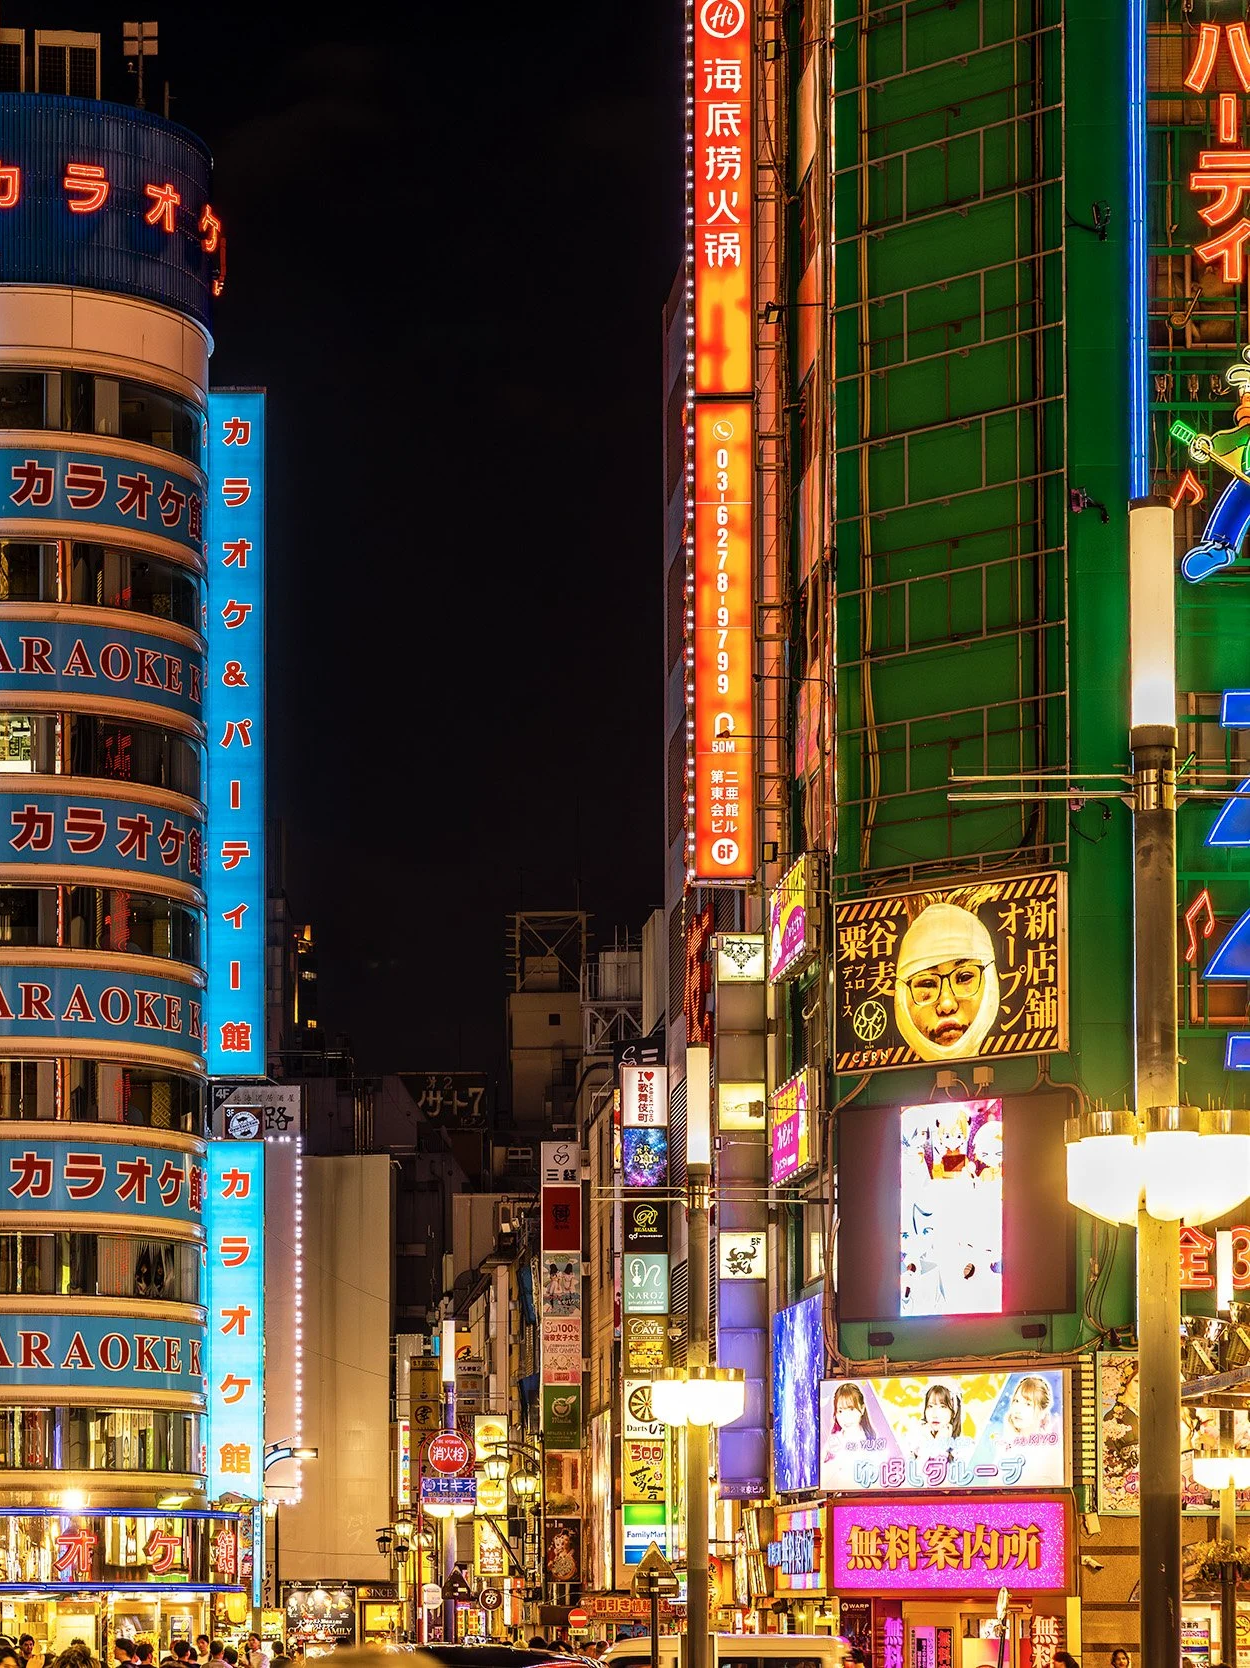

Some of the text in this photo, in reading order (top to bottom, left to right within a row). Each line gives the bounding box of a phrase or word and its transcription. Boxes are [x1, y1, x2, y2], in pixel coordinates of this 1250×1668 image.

[703, 57, 742, 268] 海底捞火锅
[716, 448, 730, 694] 03-6278-9799
[711, 740, 736, 753] 50M
[717, 844, 734, 859] 6F
[996, 901, 1027, 1033] オープン
[1023, 896, 1060, 1031] 新店舗
[852, 1050, 890, 1063] CERN
[215, 1088, 230, 1099] 4F
[638, 1083, 649, 1122] 歌舞伎町
[226, 1108, 235, 1118] 3F
[628, 1291, 664, 1300] NAROZ
[219, 1167, 251, 1475] カラオケ館
[628, 1318, 664, 1335] CAVE
[626, 1424, 648, 1432] Darts
[860, 1438, 887, 1451] YUKI
[1028, 1433, 1059, 1446] KIYO
[432, 1446, 465, 1462] 消火栓
[631, 1444, 664, 1462] 300
[853, 1455, 1027, 1489] ゆほしグループ
[437, 1478, 477, 1492] セキネ
[626, 1530, 667, 1540] FamilyMart
[846, 1523, 1044, 1571] 無料案内所
